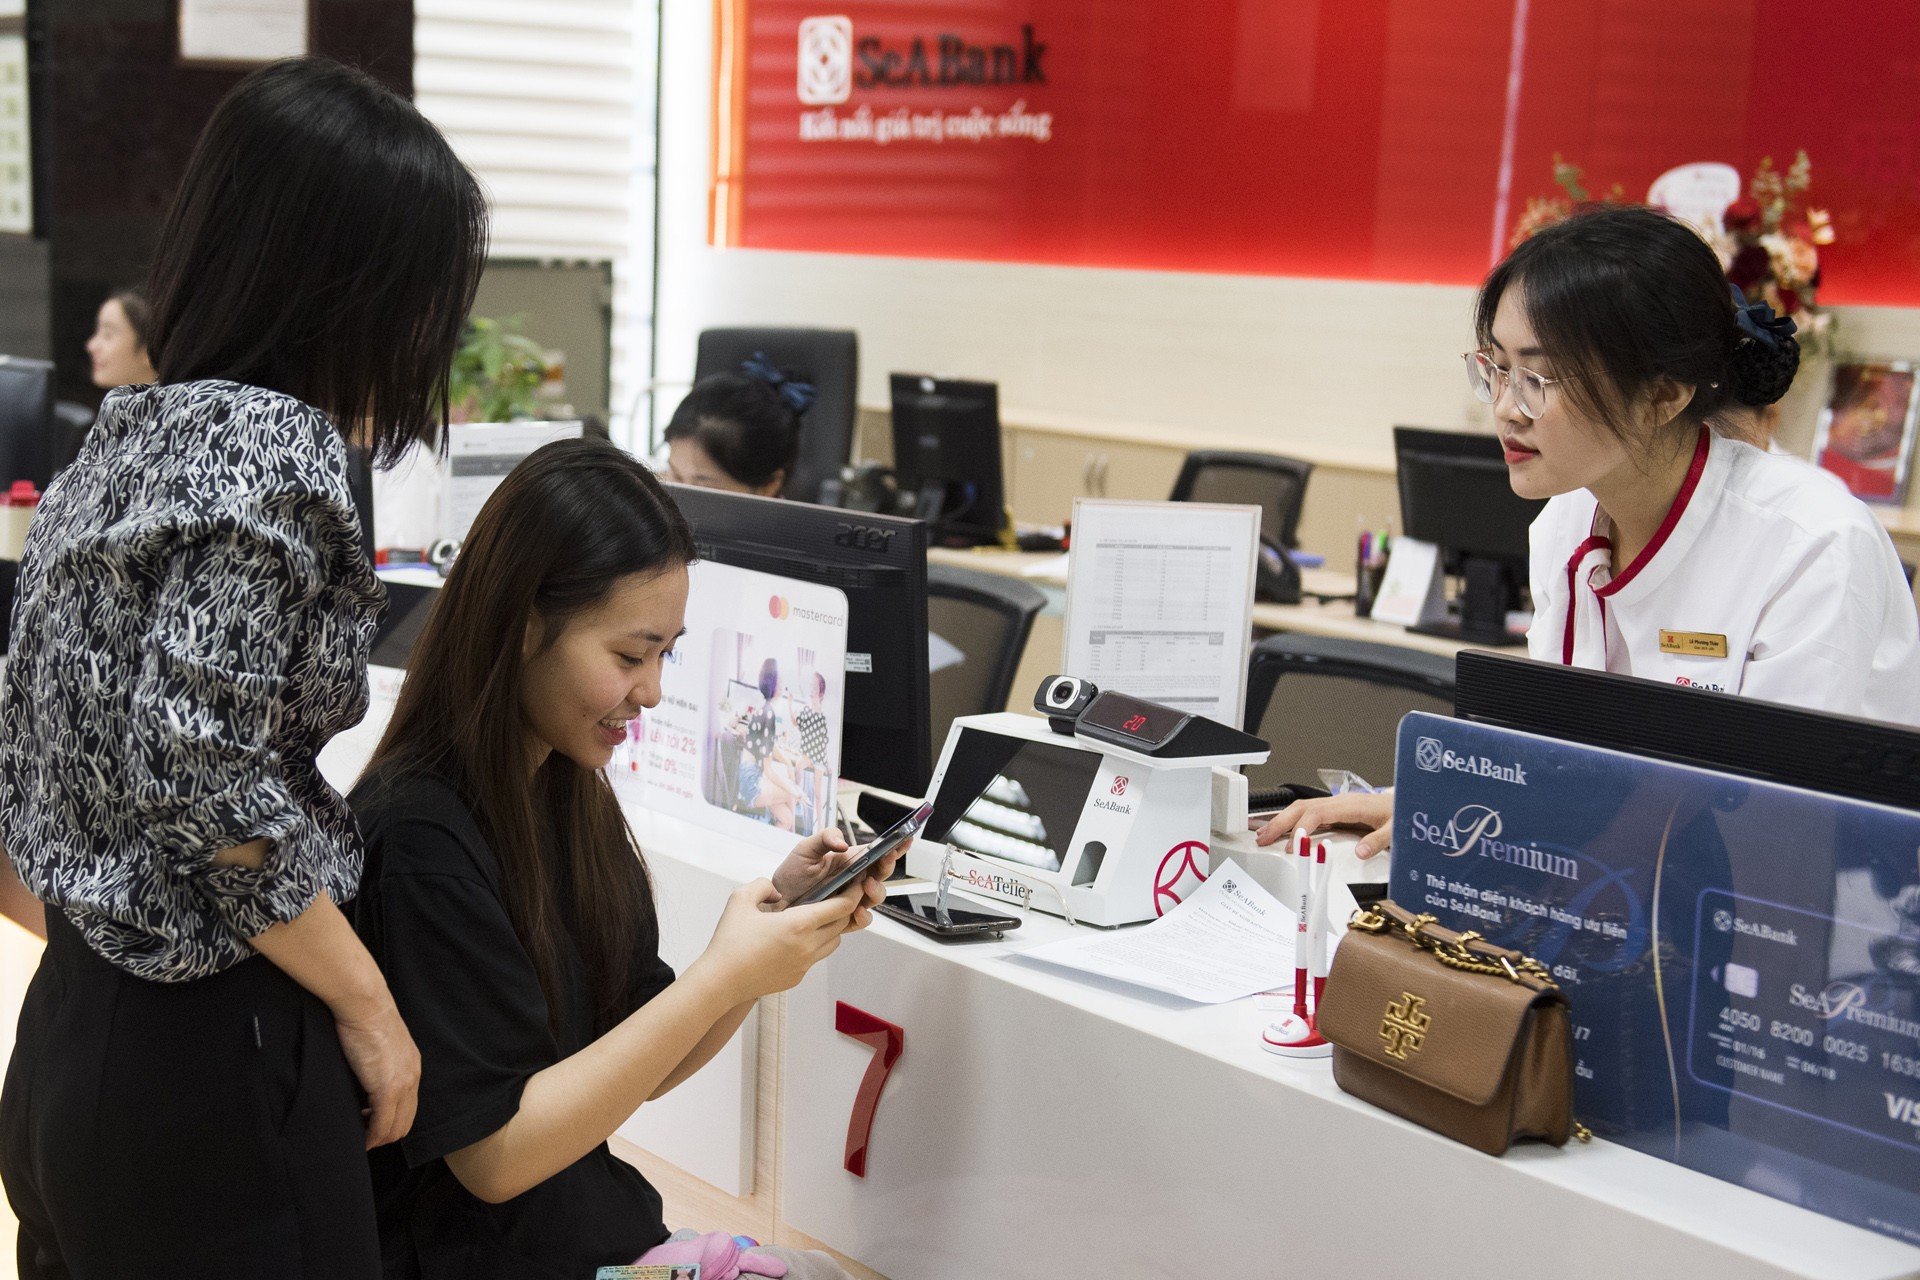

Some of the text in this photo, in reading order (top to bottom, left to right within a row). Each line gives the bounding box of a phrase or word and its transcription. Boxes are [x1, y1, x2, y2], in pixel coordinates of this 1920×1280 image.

[855, 23, 1047, 87] SeABank
[835, 522, 896, 552] acer
[793, 605, 843, 627] mastercard
[1122, 714, 1146, 732] 20
[1442, 750, 1527, 785] SeABank
[1093, 798, 1132, 815] SeABank
[968, 869, 1033, 900] SeATeller
[1233, 889, 1267, 917] SeABank
[1424, 891, 1501, 924] của SeABank
[1426, 873, 1446, 890] Thẻ
[1448, 881, 1478, 900] nhận
[1508, 895, 1548, 918] khách
[1549, 906, 1583, 931] hàng
[1733, 917, 1798, 946] SeABank
[1719, 1006, 1761, 1032] 4050
[1769, 1020, 1814, 1047] 8200
[1823, 1035, 1870, 1063] 0025
[834, 999, 905, 1179] 7
